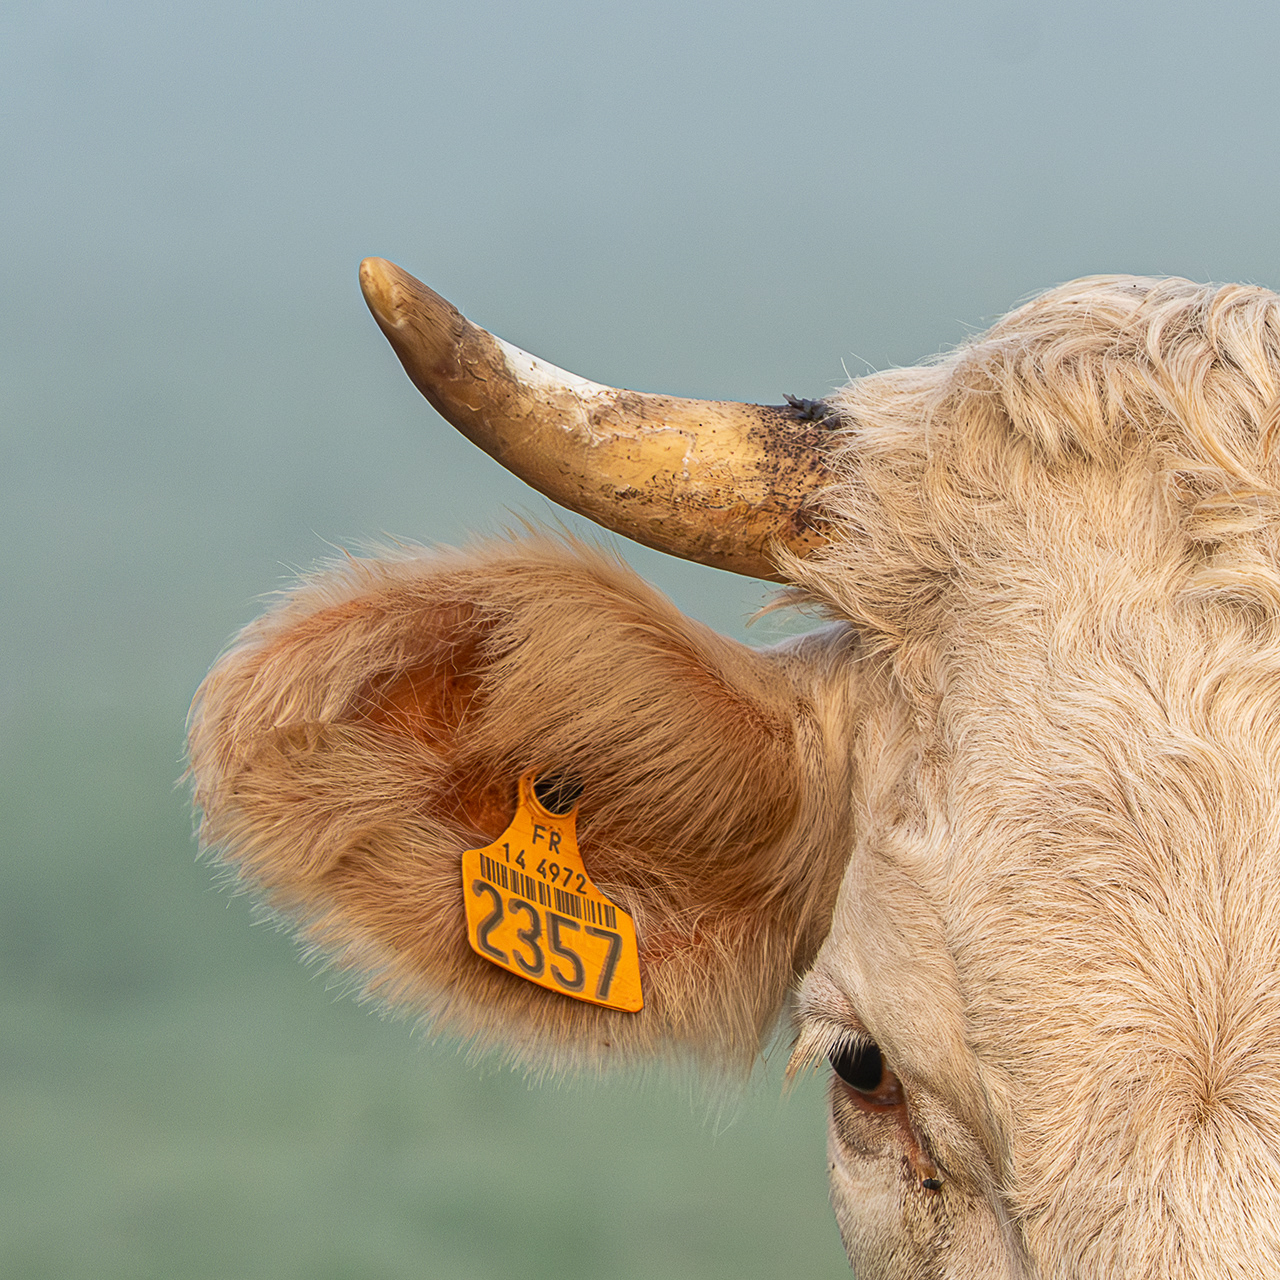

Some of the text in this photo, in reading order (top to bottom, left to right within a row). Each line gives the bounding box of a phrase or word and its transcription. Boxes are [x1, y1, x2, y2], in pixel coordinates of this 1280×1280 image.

[532, 824, 562, 855] FR
[502, 842, 587, 894] 14 4972
[472, 878, 623, 1001] 2357
